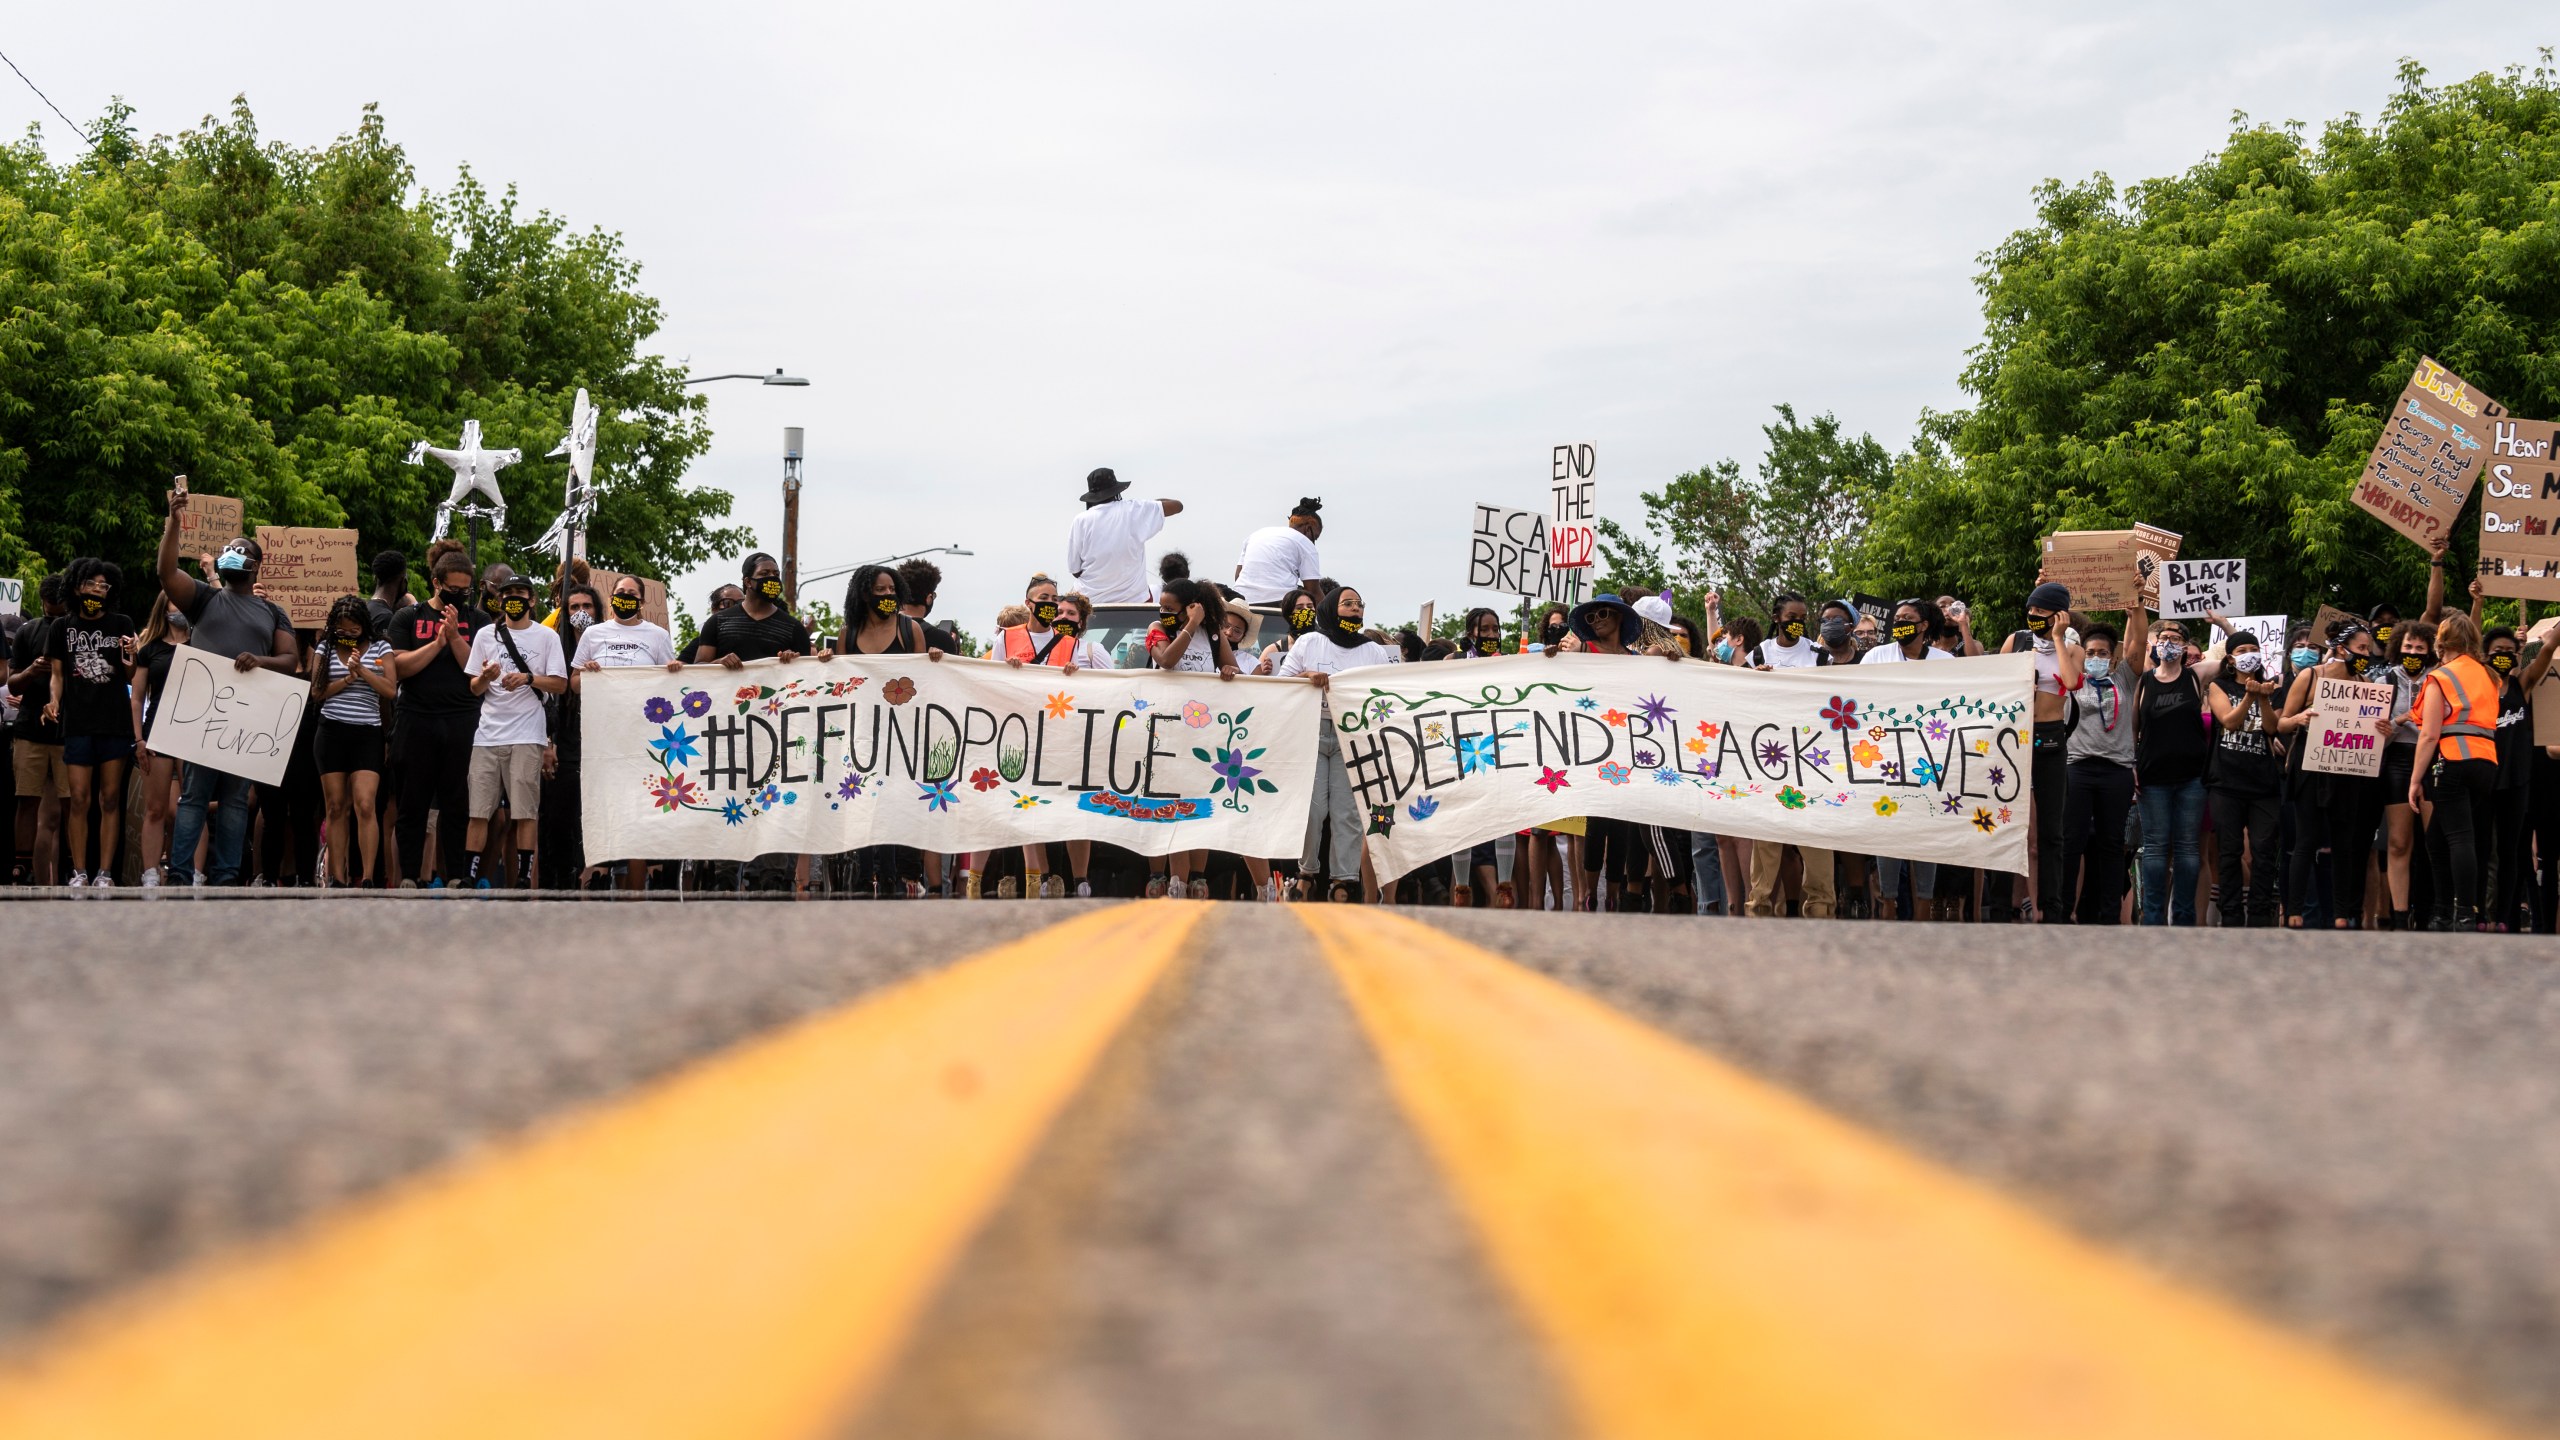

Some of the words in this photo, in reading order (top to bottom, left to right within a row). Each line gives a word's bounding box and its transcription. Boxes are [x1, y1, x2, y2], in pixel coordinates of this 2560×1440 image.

[2414, 358, 2478, 417] Justice
[2493, 421, 2548, 458] Hear
[1553, 443, 1594, 481] END
[2438, 441, 2472, 471] Floyd
[2430, 457, 2459, 481] Bland
[2427, 474, 2465, 505] Arbery
[2487, 464, 2532, 499] See
[1552, 482, 1594, 521] THE
[2407, 481, 2432, 508] Rice
[1474, 505, 1500, 537] I
[2524, 515, 2547, 535] Kill
[180, 531, 194, 540] ntil
[262, 533, 283, 550] You
[291, 535, 315, 548] Can't
[317, 535, 353, 550] Seperate
[2164, 538, 2177, 547] FOR
[1552, 527, 1593, 566] MPD
[261, 553, 304, 564] FREEDOM
[311, 554, 331, 563] from
[261, 566, 297, 578] PEACE
[304, 568, 343, 578] because
[2168, 561, 2241, 587] BLACK
[327, 584, 341, 593] be
[291, 595, 327, 605] UNLESS
[612, 600, 636, 609] POLICE
[2261, 619, 2285, 647] Dept
[2154, 692, 2184, 707] NIKE
[2321, 681, 2391, 704] BLACKNESS
[2324, 703, 2349, 713] SHOULD
[2359, 705, 2383, 717] NOT
[2336, 719, 2349, 728] BE
[2323, 730, 2374, 749] DEATH
[2310, 747, 2377, 767] SENTENCE
